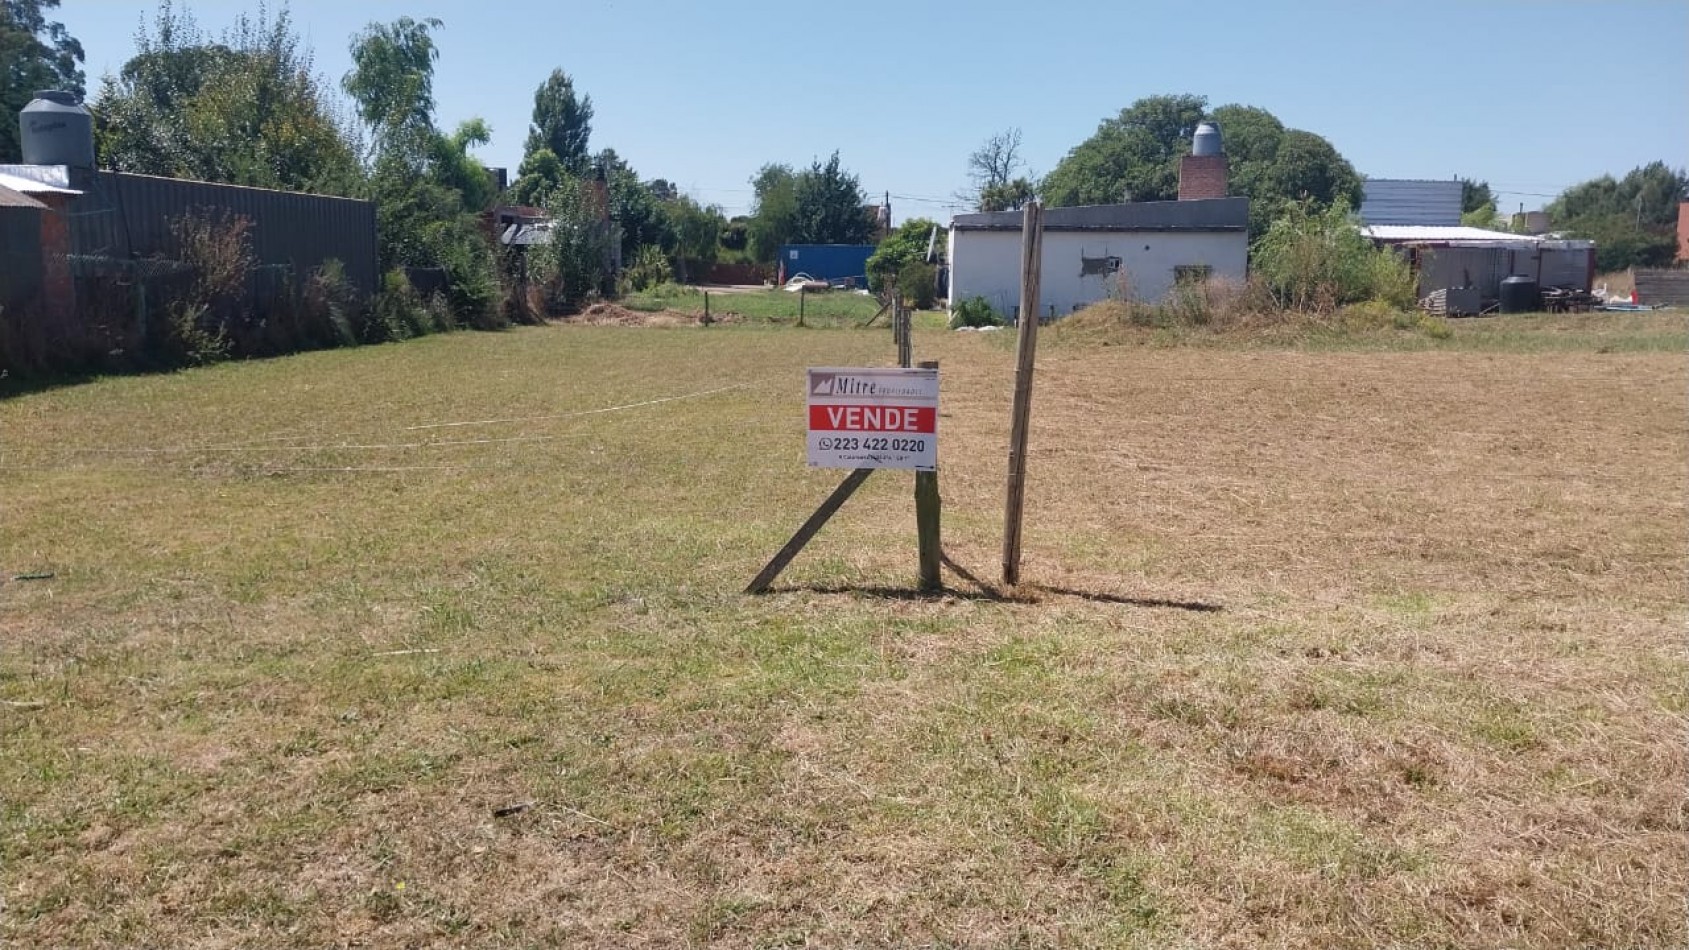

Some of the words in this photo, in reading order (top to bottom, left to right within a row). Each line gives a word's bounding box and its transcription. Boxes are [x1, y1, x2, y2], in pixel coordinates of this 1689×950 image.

[835, 377, 876, 395] Mitre
[827, 407, 919, 430] VENDE
[833, 437, 859, 450] 223
[862, 438, 889, 451] 422
[892, 438, 925, 452] 0220
